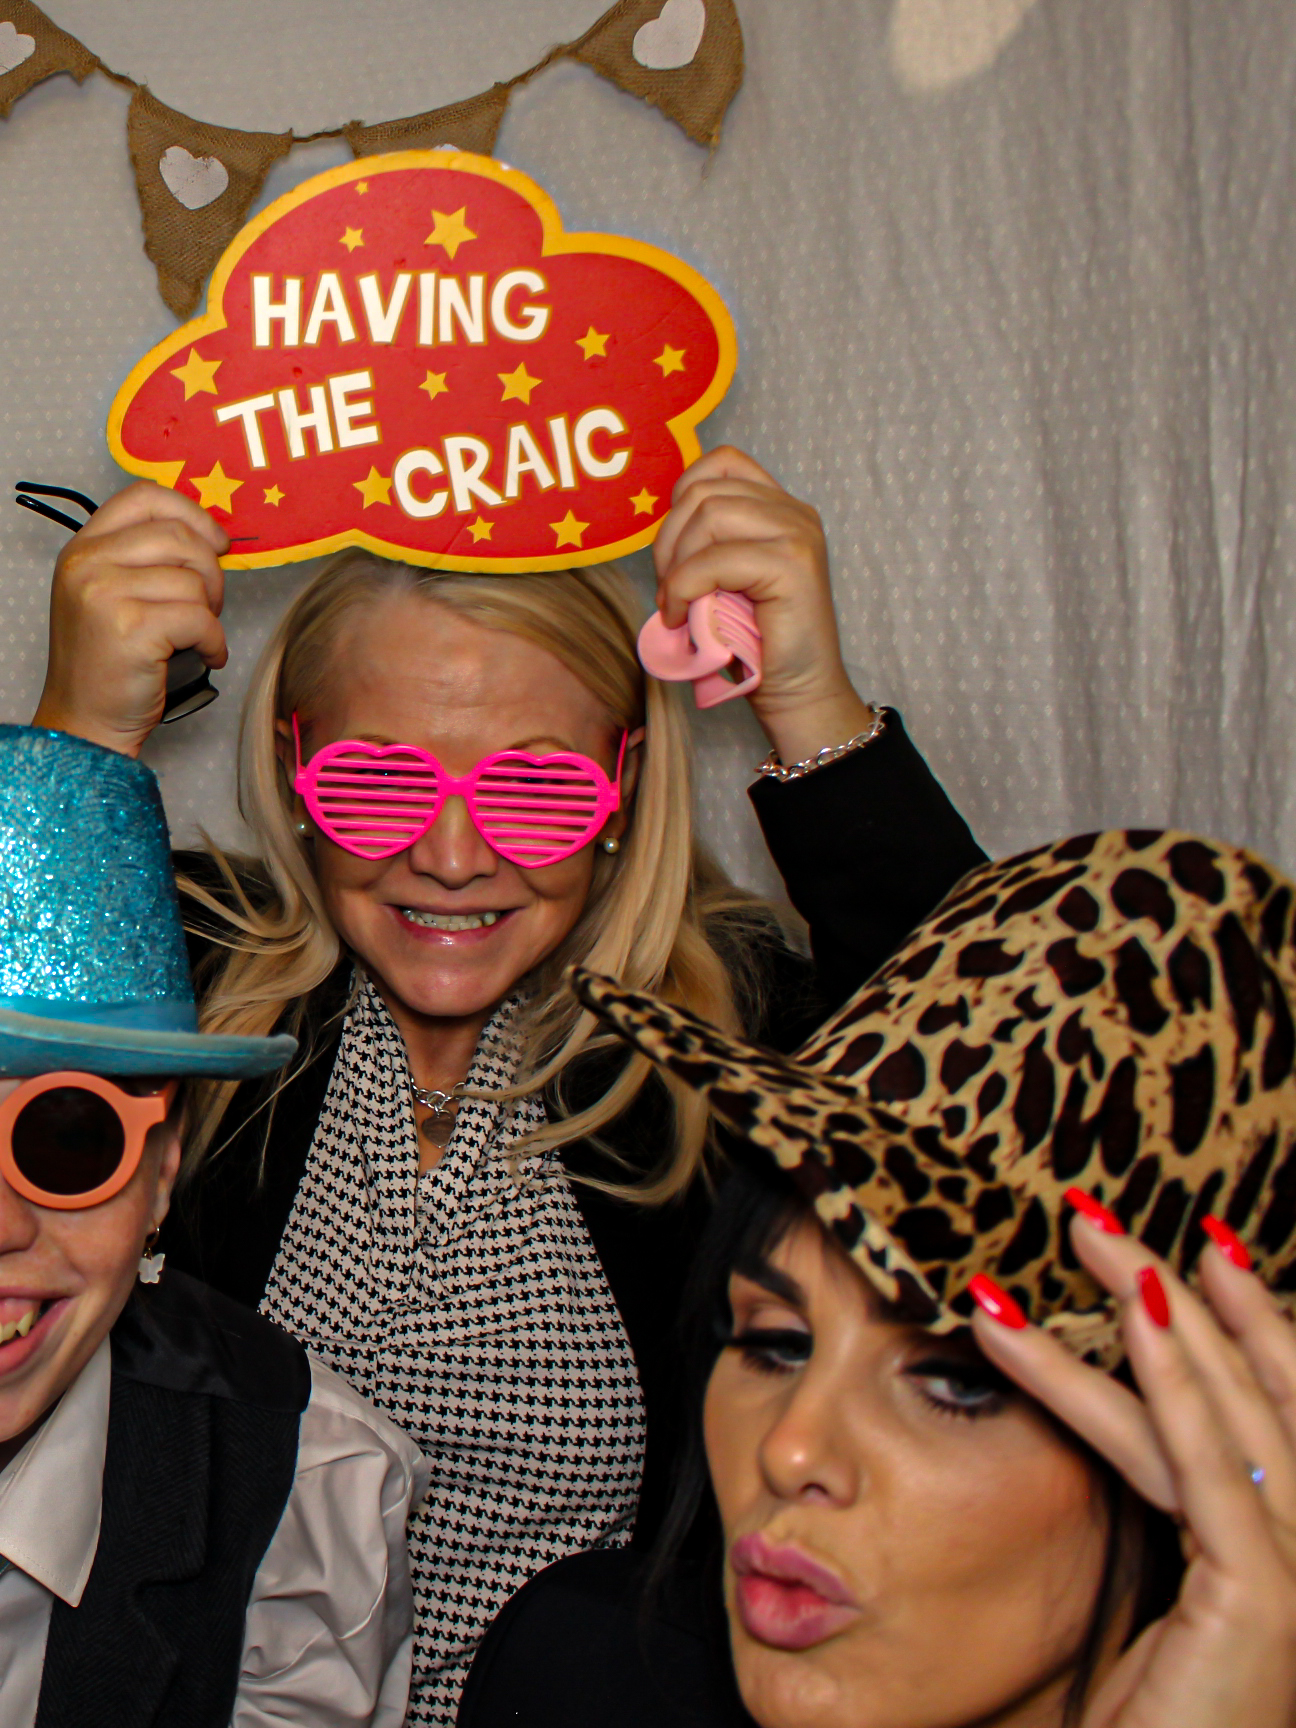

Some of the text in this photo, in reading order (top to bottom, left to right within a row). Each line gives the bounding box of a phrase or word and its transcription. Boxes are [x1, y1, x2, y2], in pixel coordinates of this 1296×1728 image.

[252, 271, 549, 346] HAVING
[216, 371, 379, 468] THE
[392, 408, 631, 518] CRAIC
